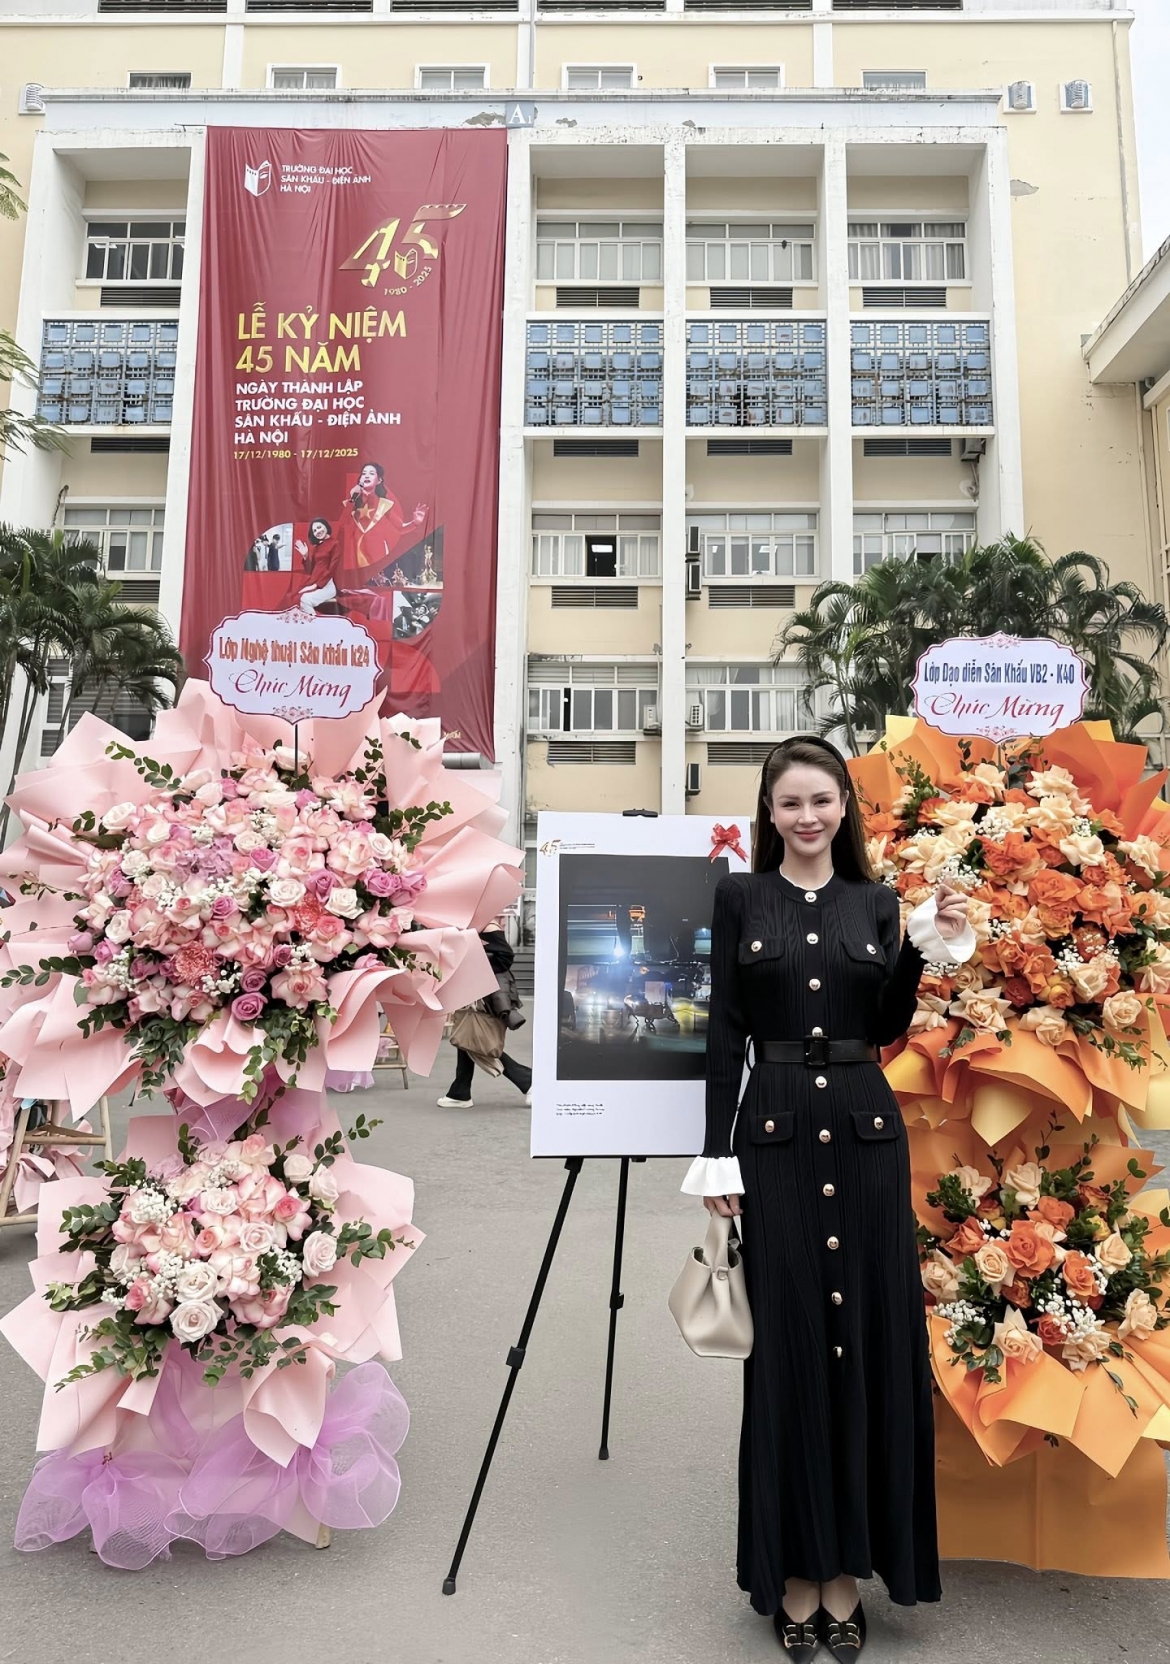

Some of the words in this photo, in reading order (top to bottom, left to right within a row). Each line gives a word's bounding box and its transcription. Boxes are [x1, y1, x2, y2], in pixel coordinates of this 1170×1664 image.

[282, 163, 317, 174] TRƯỜNG
[335, 166, 353, 175] HỌC
[353, 174, 371, 183] ẢNH
[280, 184, 292, 192] HÀ
[295, 184, 311, 194] NỘI
[413, 265, 432, 287] 2025
[237, 301, 267, 340] LỄ
[277, 305, 319, 340] KỶ
[329, 305, 407, 344] NIỆM
[235, 345, 274, 373] 45
[285, 341, 361, 374] NĂM
[236, 379, 279, 395] NGÀY
[282, 379, 333, 394] THÀNH
[337, 378, 364, 395] LẬP
[235, 395, 298, 411] TRƯỜNG
[301, 397, 328, 413] ĐẠI
[333, 396, 365, 412] HỌC
[235, 413, 265, 428] SÂN
[269, 410, 313, 427] KHẤU
[327, 411, 362, 428] ĐIỆN
[366, 409, 401, 425] ẢNH
[234, 430, 256, 444] HÀ
[259, 429, 288, 446] NỘI
[233, 449, 292, 460] 17/12/1980
[300, 448, 359, 459] 17/12/2025
[219, 636, 238, 662] Lớp
[240, 637, 269, 666] Nghệ
[300, 641, 319, 665] Sân
[924, 661, 940, 684] Lớp
[962, 658, 982, 683] diễn
[1004, 658, 1028, 683] Khấu
[1030, 663, 1048, 683] VB2
[1056, 663, 1075, 684] K40
[229, 668, 288, 697] Chúc
[283, 674, 352, 708] Mừng
[923, 692, 990, 719] Chúc
[984, 695, 1065, 728] Mừng
